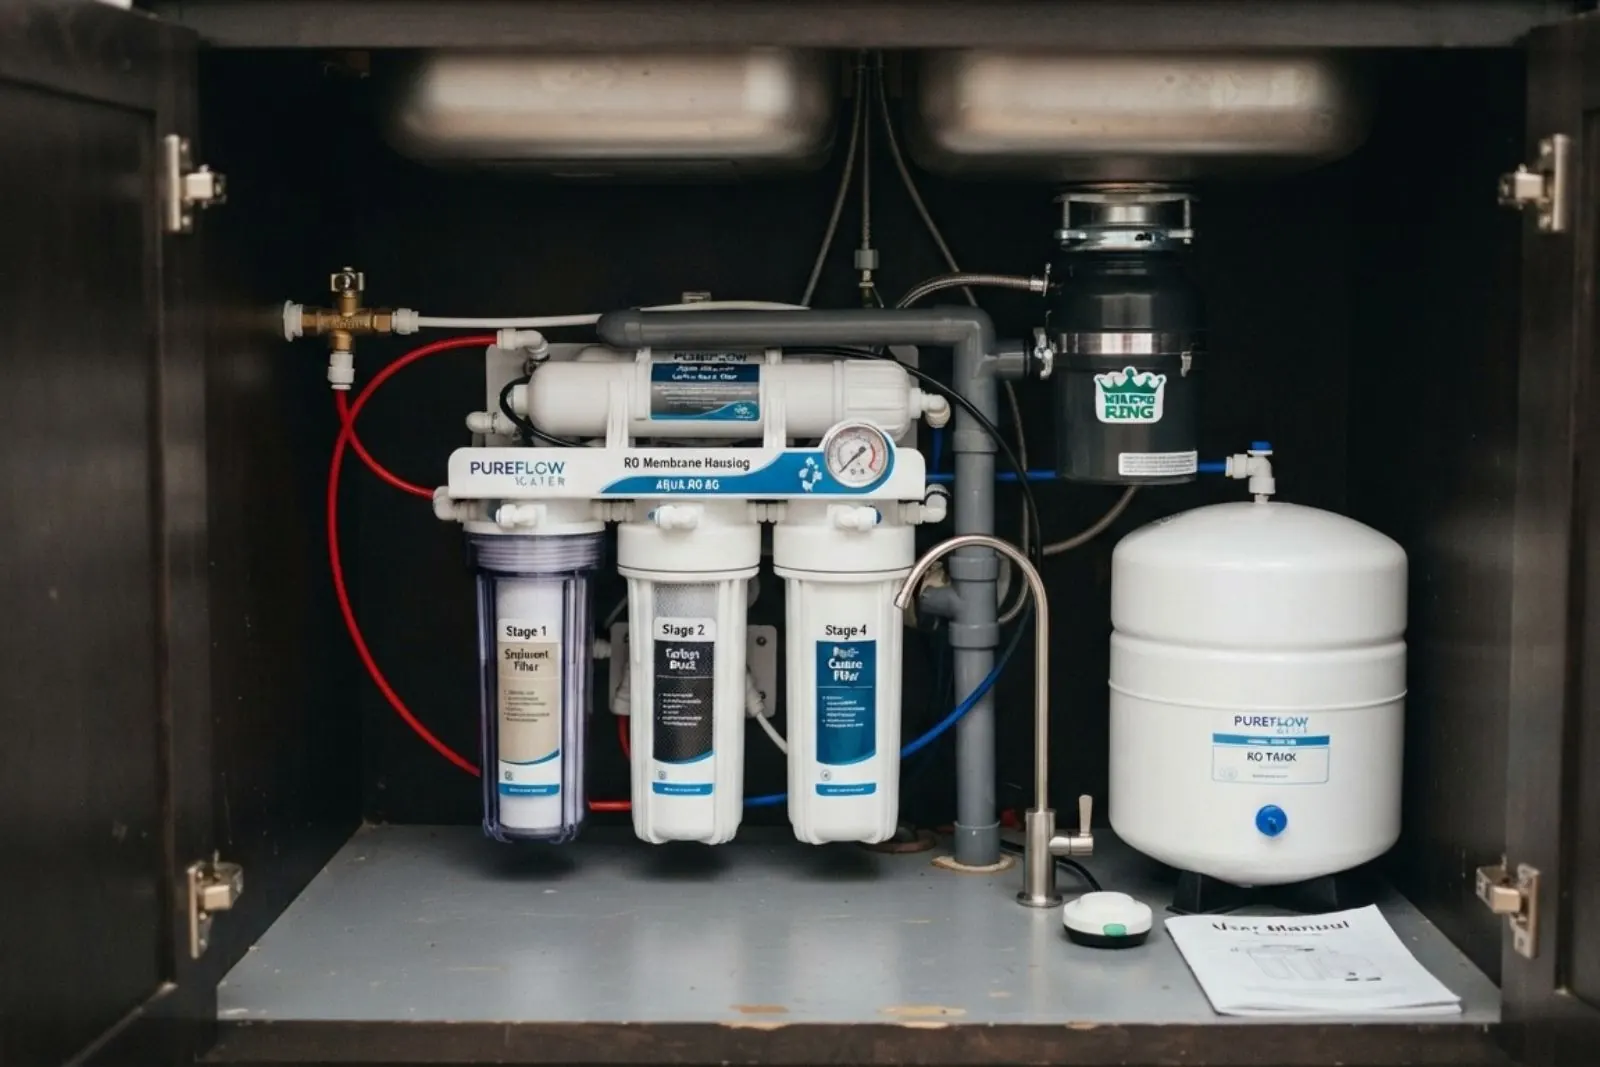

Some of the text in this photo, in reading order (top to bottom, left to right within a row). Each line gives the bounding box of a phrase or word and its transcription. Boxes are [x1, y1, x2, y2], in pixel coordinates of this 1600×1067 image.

[470, 461, 565, 475] PUREFLOW
[624, 457, 640, 469] RO
[506, 625, 547, 640] Stage 1
[698, 624, 705, 636] 2
[825, 624, 867, 640] Stage 4
